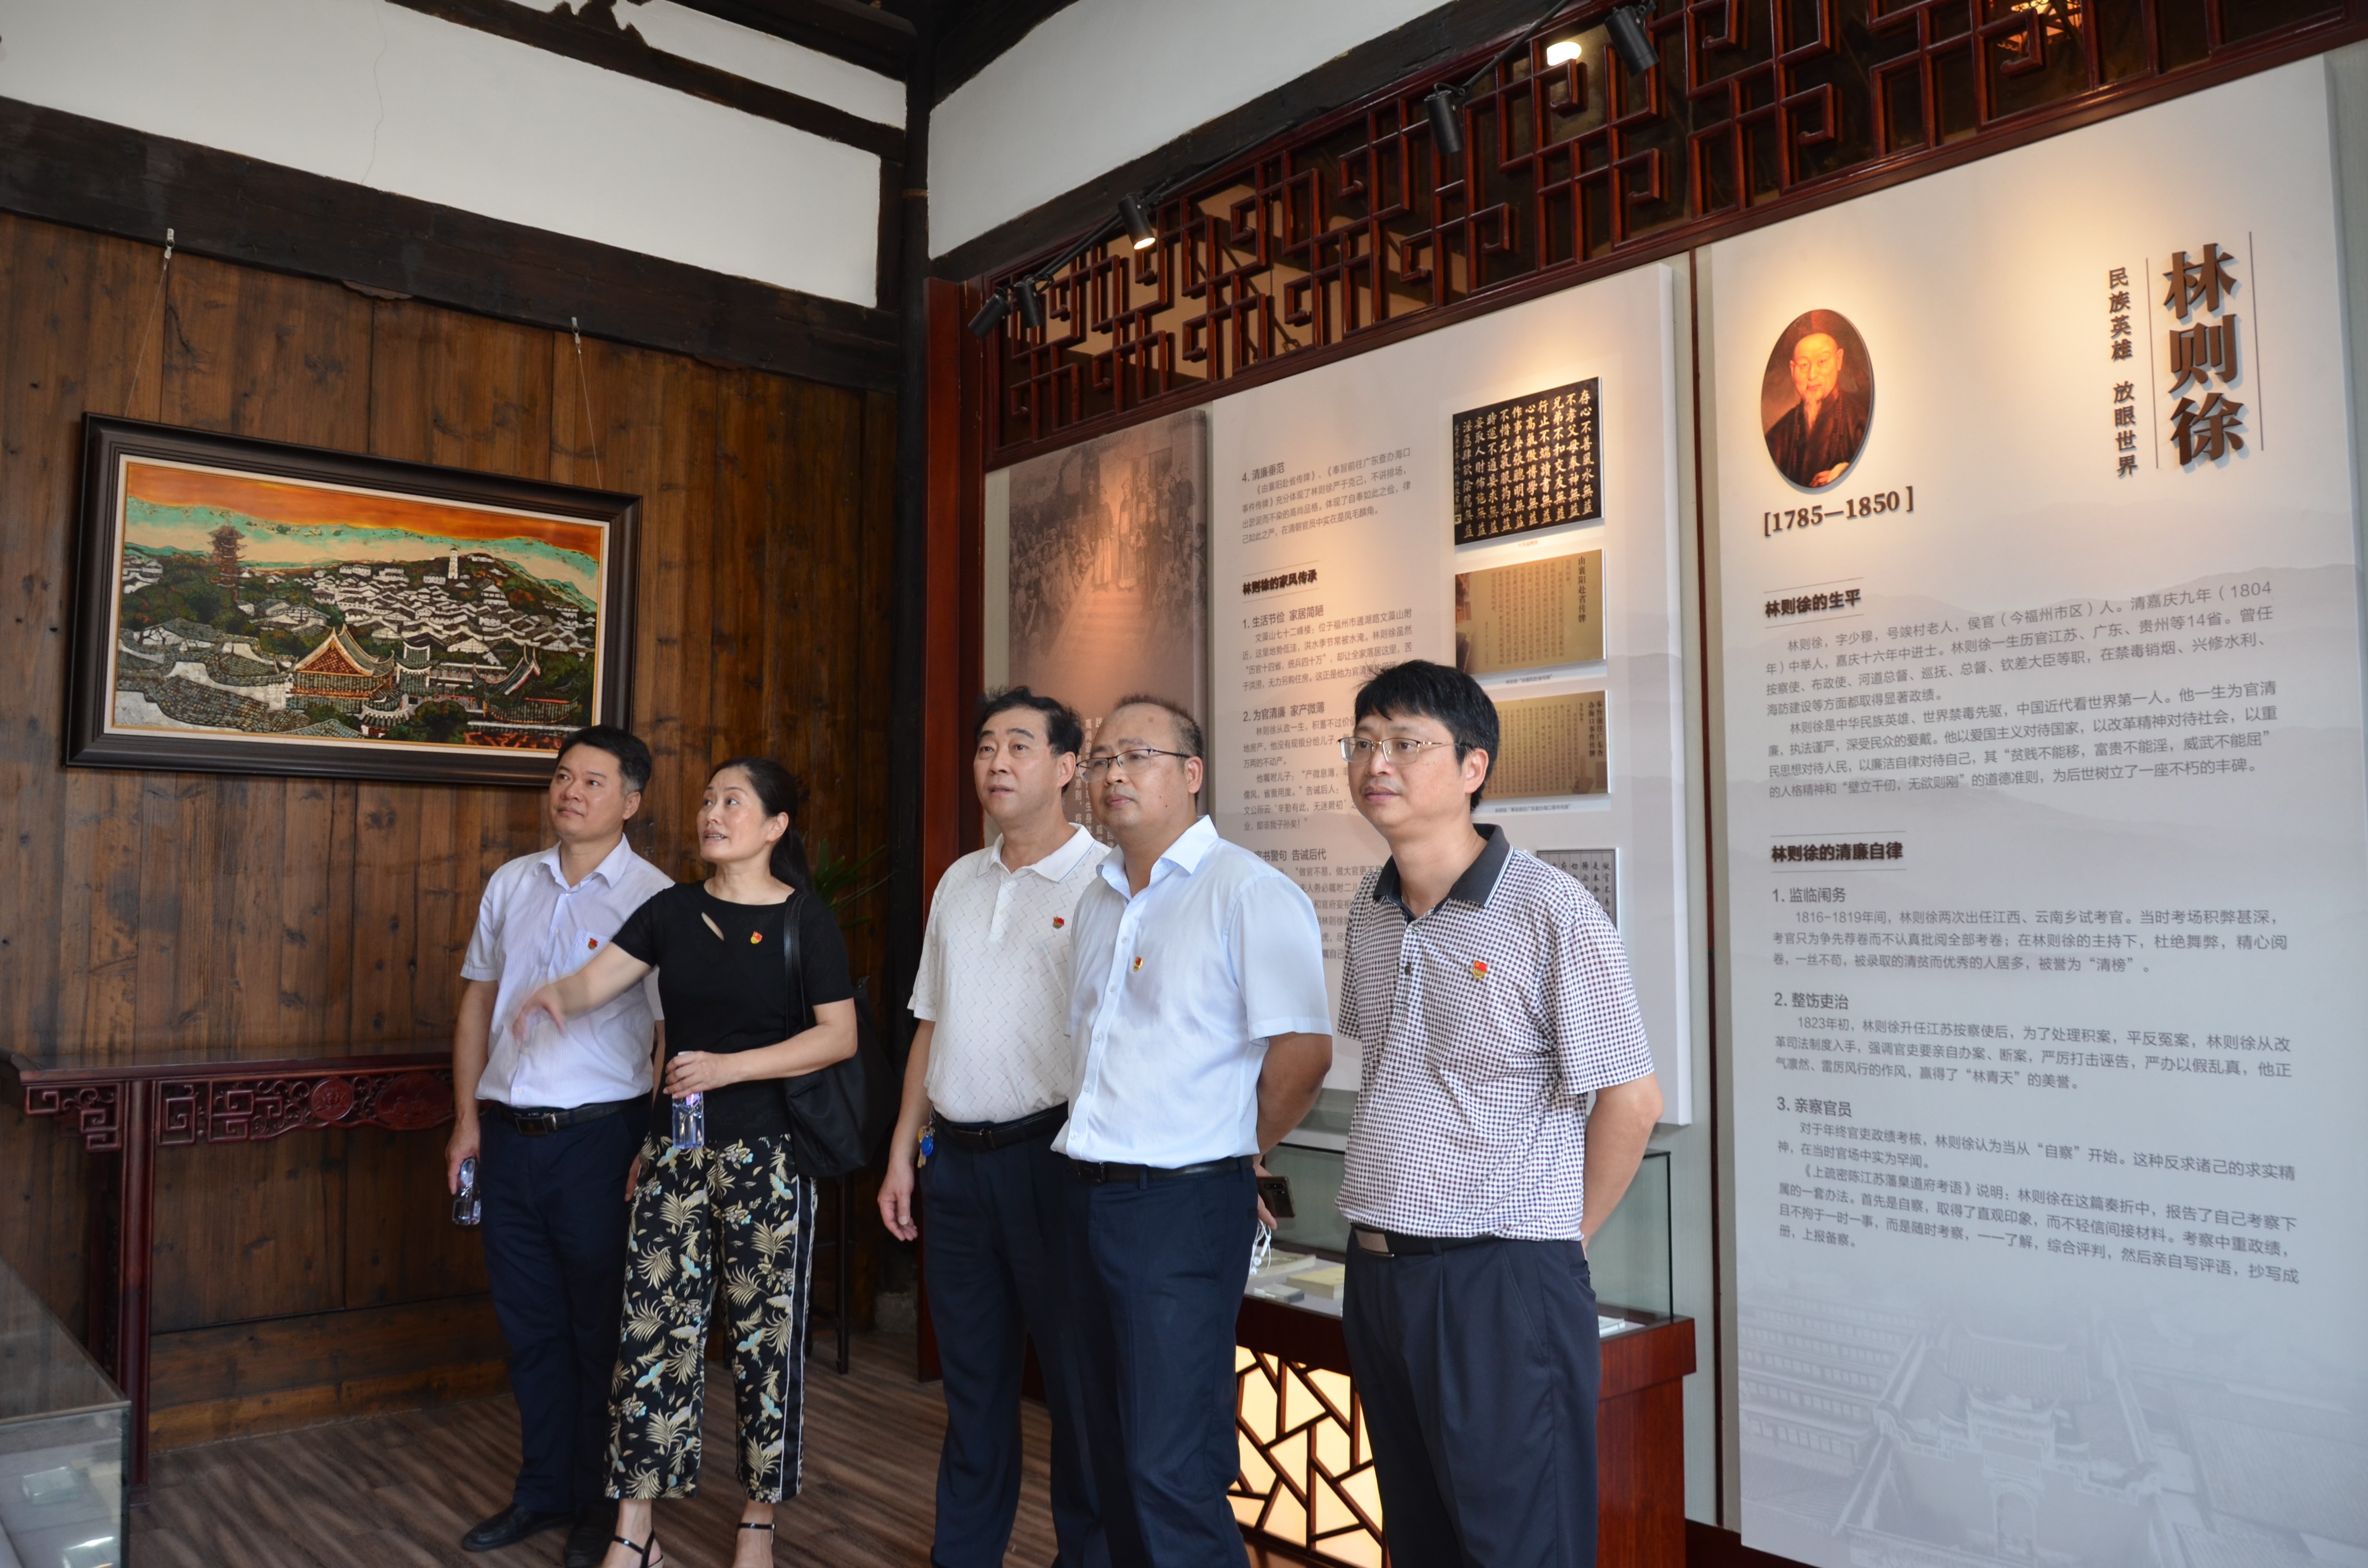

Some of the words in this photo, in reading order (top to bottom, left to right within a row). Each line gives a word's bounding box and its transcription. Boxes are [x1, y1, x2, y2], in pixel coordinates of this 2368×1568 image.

[2109, 266, 2133, 362] 民族英雄
[2163, 243, 2246, 466] 林则徐
[2113, 381, 2138, 479] 放眼世界
[1242, 466, 1407, 514] 事件传牌》充分体现了林则徐严于克己，不讲排场，
[1242, 481, 1411, 529] 出淤泥而不染的高尚品格。体现了自奉如此之俭，律
[1242, 506, 1378, 544] 己如此之严，在清朝官员中实在是凤毛麟角。
[1242, 569, 1317, 595] 林则徐的家风传承
[1289, 605, 1324, 622] 家居简陋
[1764, 589, 1861, 618] 林则徐的生平
[1766, 632, 2265, 695] 按察使、布政使、河道总督、巡抚、总督、钦差大臣等职，在禁毒销烟、兴修水利、
[1290, 702, 1325, 717] 家产微薄
[1767, 689, 1941, 716] 海防建设等方面都取得显著政绩。
[1790, 680, 2277, 734] 林则徐是中华民族英雄、世界禁毒先驱，中国近代看世界第一人。他一生为官清
[1769, 705, 2278, 757] 廉，执法谨严，深受民众的爱戴。他以爱国主义对待国家，以改革精神对待社会，以重
[1243, 756, 1287, 769] 万两的不动产。
[1292, 849, 1327, 860] 告诫后代
[1771, 841, 1904, 863] 林则徐的清廉自律
[1773, 932, 2288, 951] 考官只为争先荐卷而不认真批阅全部考卷；在林则徐的主持下，杜绝舞弊，精心阅
[1798, 1017, 2291, 1052] 1823年初，林则徐升任江苏按察使后，为了处理积案，平反冤案，林则徐从改
[1775, 1036, 2292, 1078] 革司法制度入手，强调官吏要亲自办案、断案，严厉打击诬告，严办以假乱真，他正
[1778, 1140, 1930, 1169] 神，在当时官场中实为罕闻。
[1779, 1183, 2288, 1258] 属的一套办法。首先是自察，取得了直观印象，而不轻信间接材料。考察中重政绩，
[1779, 1225, 1857, 1248] 册，上报备察。
